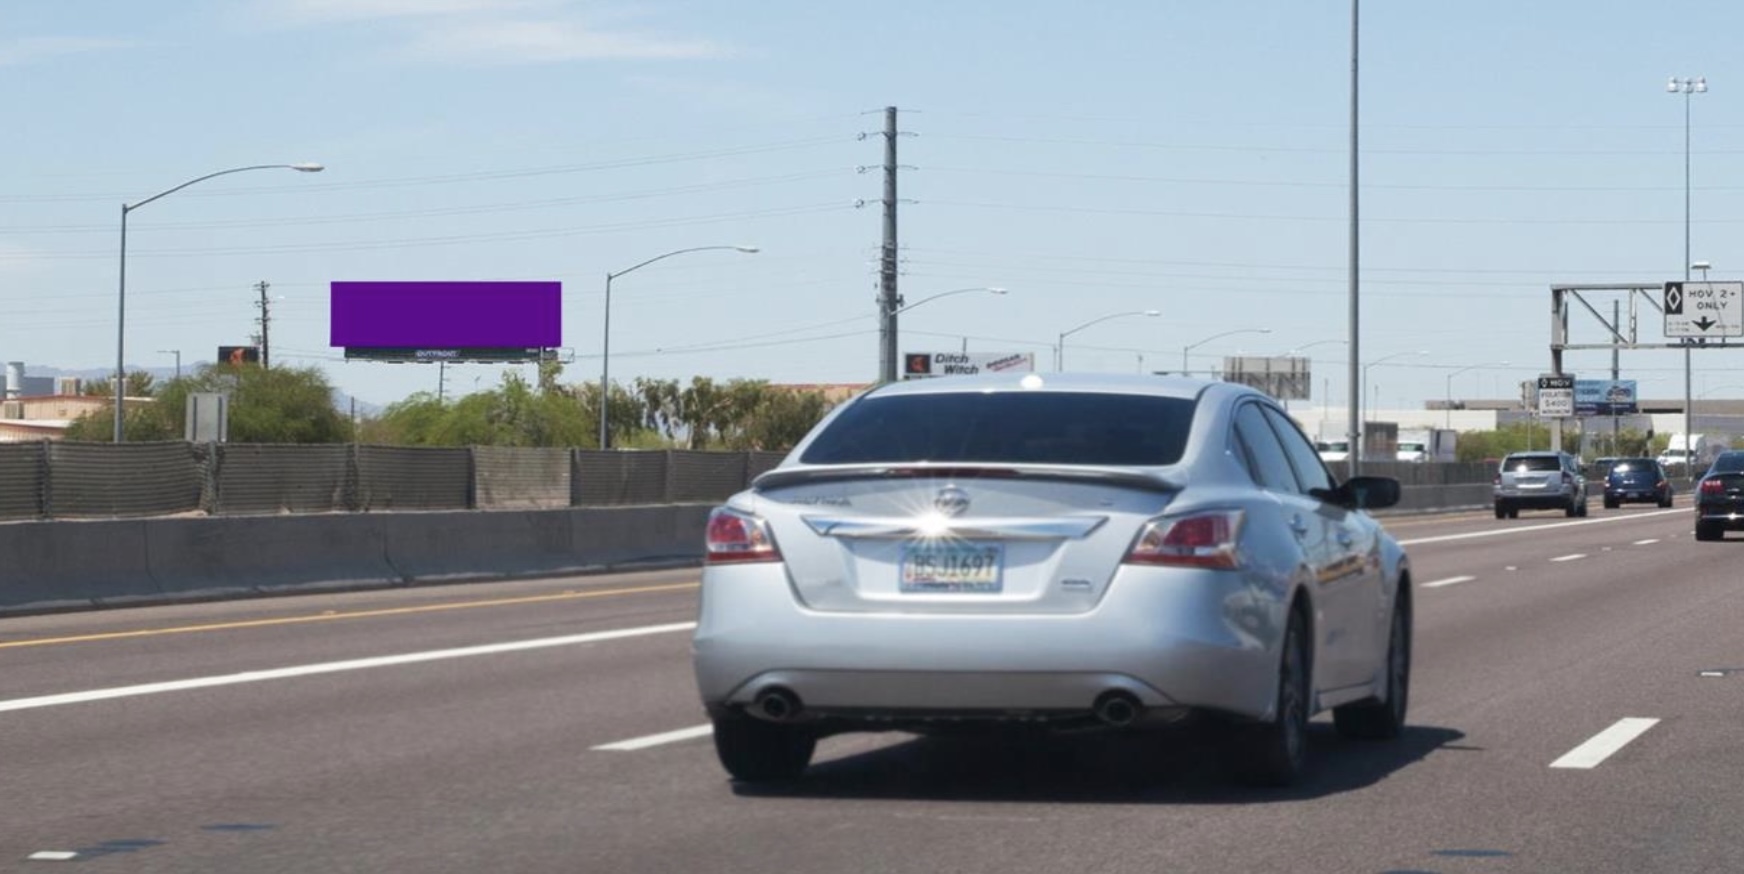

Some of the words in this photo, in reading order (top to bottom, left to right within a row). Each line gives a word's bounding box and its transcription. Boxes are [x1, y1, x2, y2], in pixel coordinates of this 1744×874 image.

[1689, 289, 1714, 299] HOV
[1696, 302, 1727, 310] ONLY
[935, 353, 969, 364] Ditch
[944, 365, 979, 375] Witch
